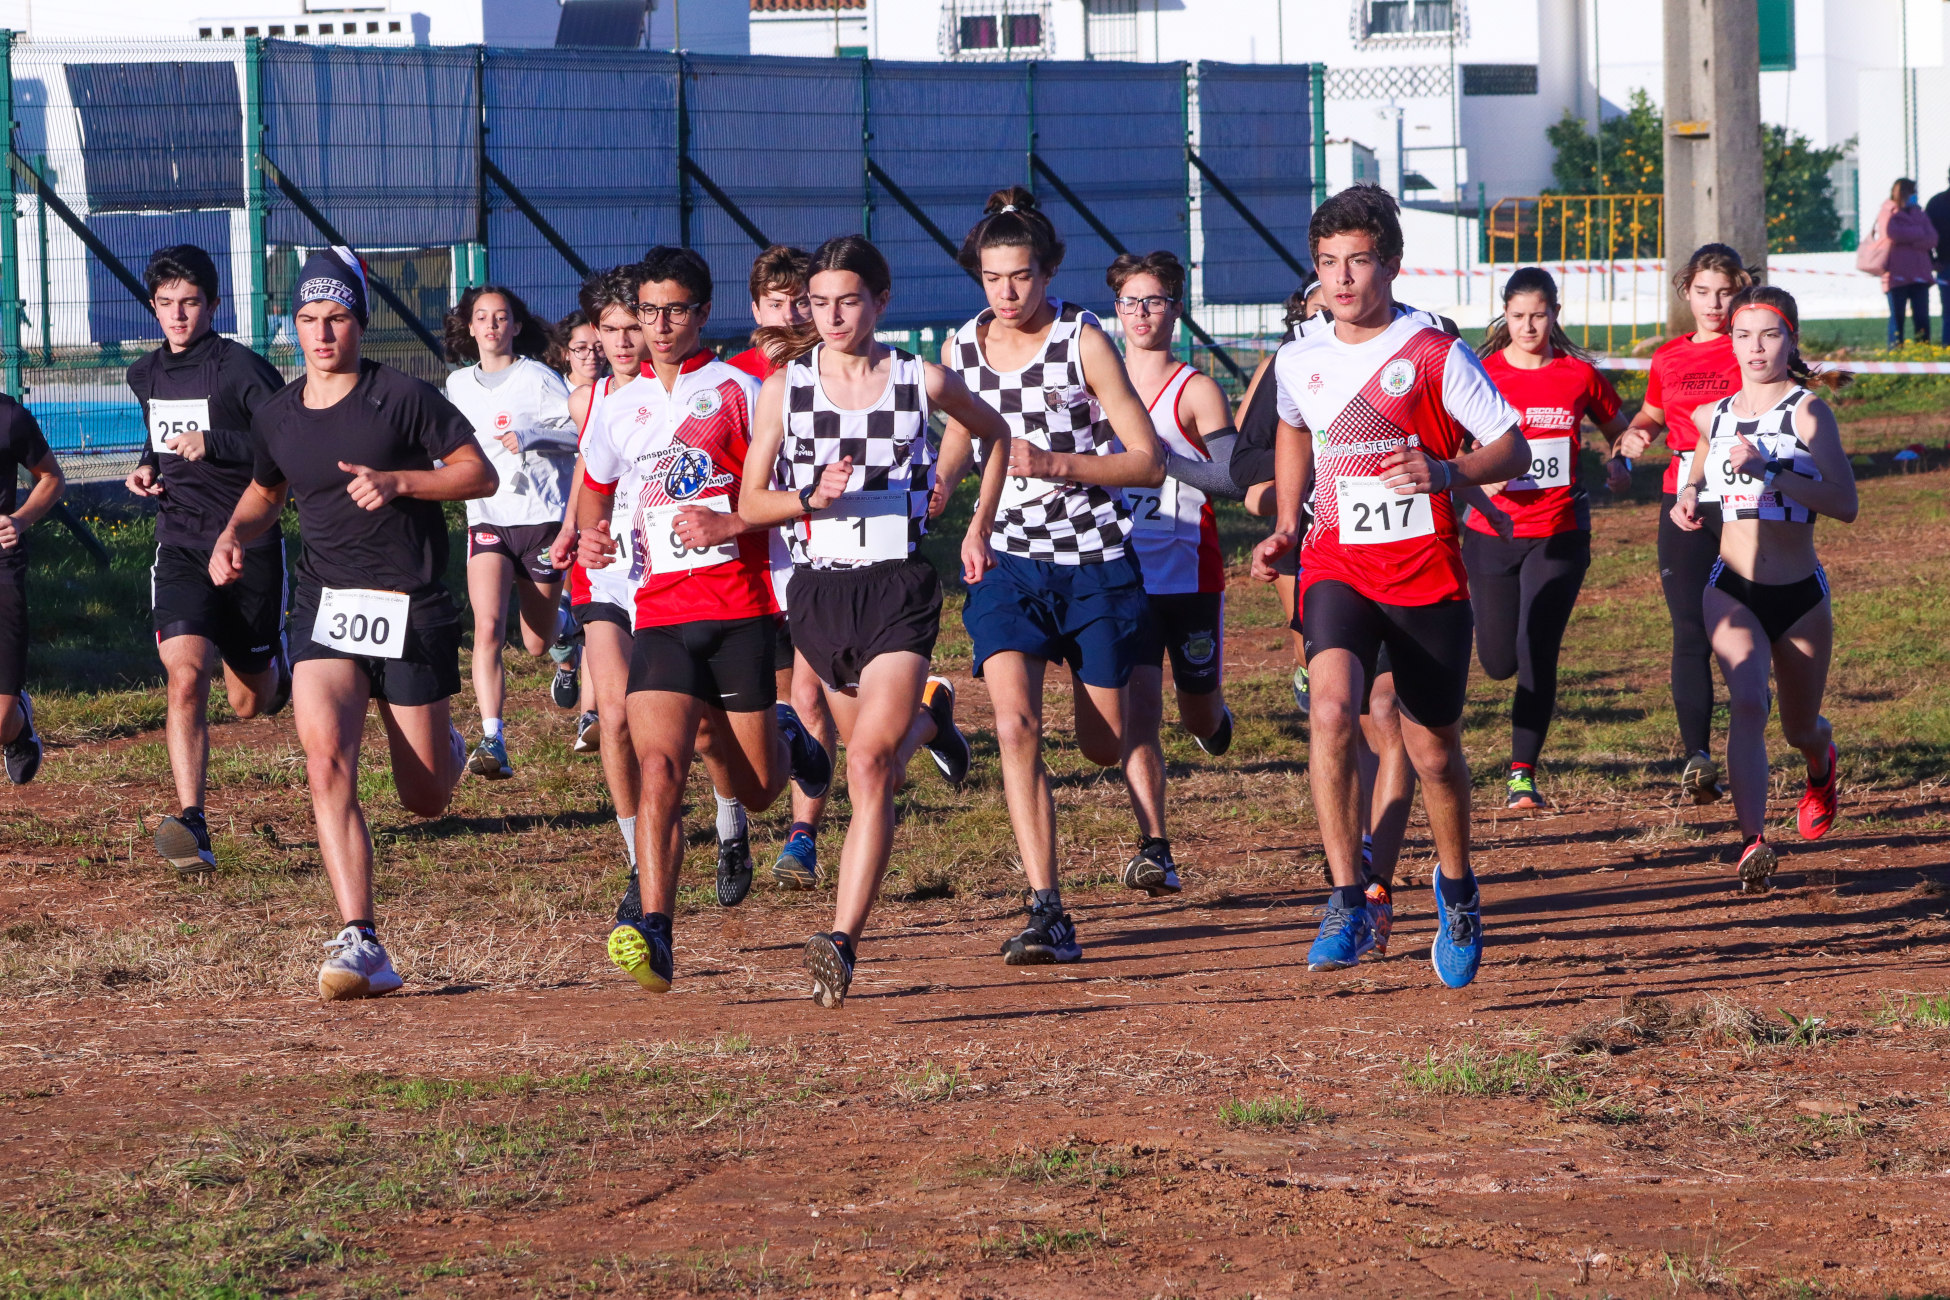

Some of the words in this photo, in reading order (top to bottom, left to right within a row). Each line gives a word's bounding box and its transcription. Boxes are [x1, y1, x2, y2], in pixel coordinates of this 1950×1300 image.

[708, 474, 732, 486] Anjos
[1517, 457, 1560, 480] 98
[1352, 498, 1414, 532] 217
[852, 517, 866, 547] 1
[328, 613, 390, 645] 300
